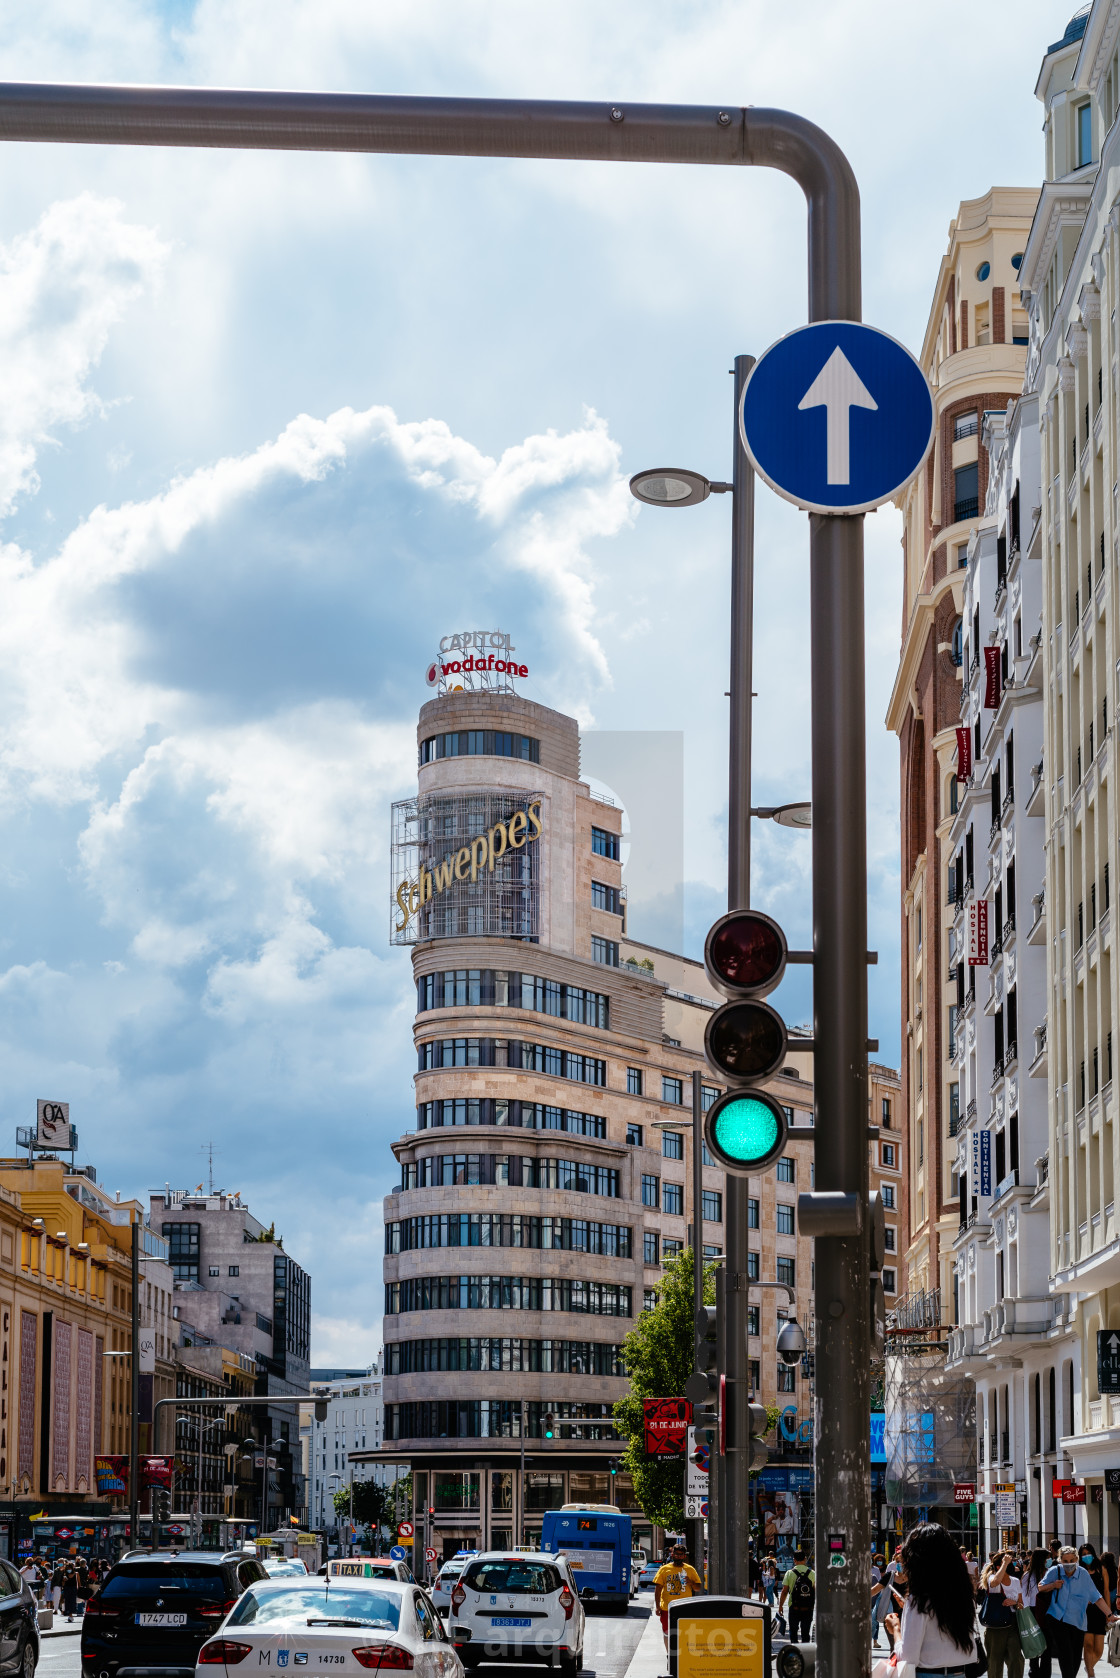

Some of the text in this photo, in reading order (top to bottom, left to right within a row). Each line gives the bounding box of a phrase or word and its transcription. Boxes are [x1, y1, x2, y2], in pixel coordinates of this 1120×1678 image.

[439, 631, 516, 653] CAPITOL
[441, 654, 529, 678] vodafone
[396, 800, 543, 932] Schweppes
[0, 1312, 9, 1478] CALLAO
[650, 1420, 687, 1430] 21 DE JUNIO
[581, 1521, 590, 1529] 74
[343, 1564, 362, 1576] TAXI
[142, 1614, 185, 1624] 1747 LCD
[496, 1618, 514, 1626] 8363
[259, 1650, 271, 1666] M
[318, 1655, 345, 1664] 14730
